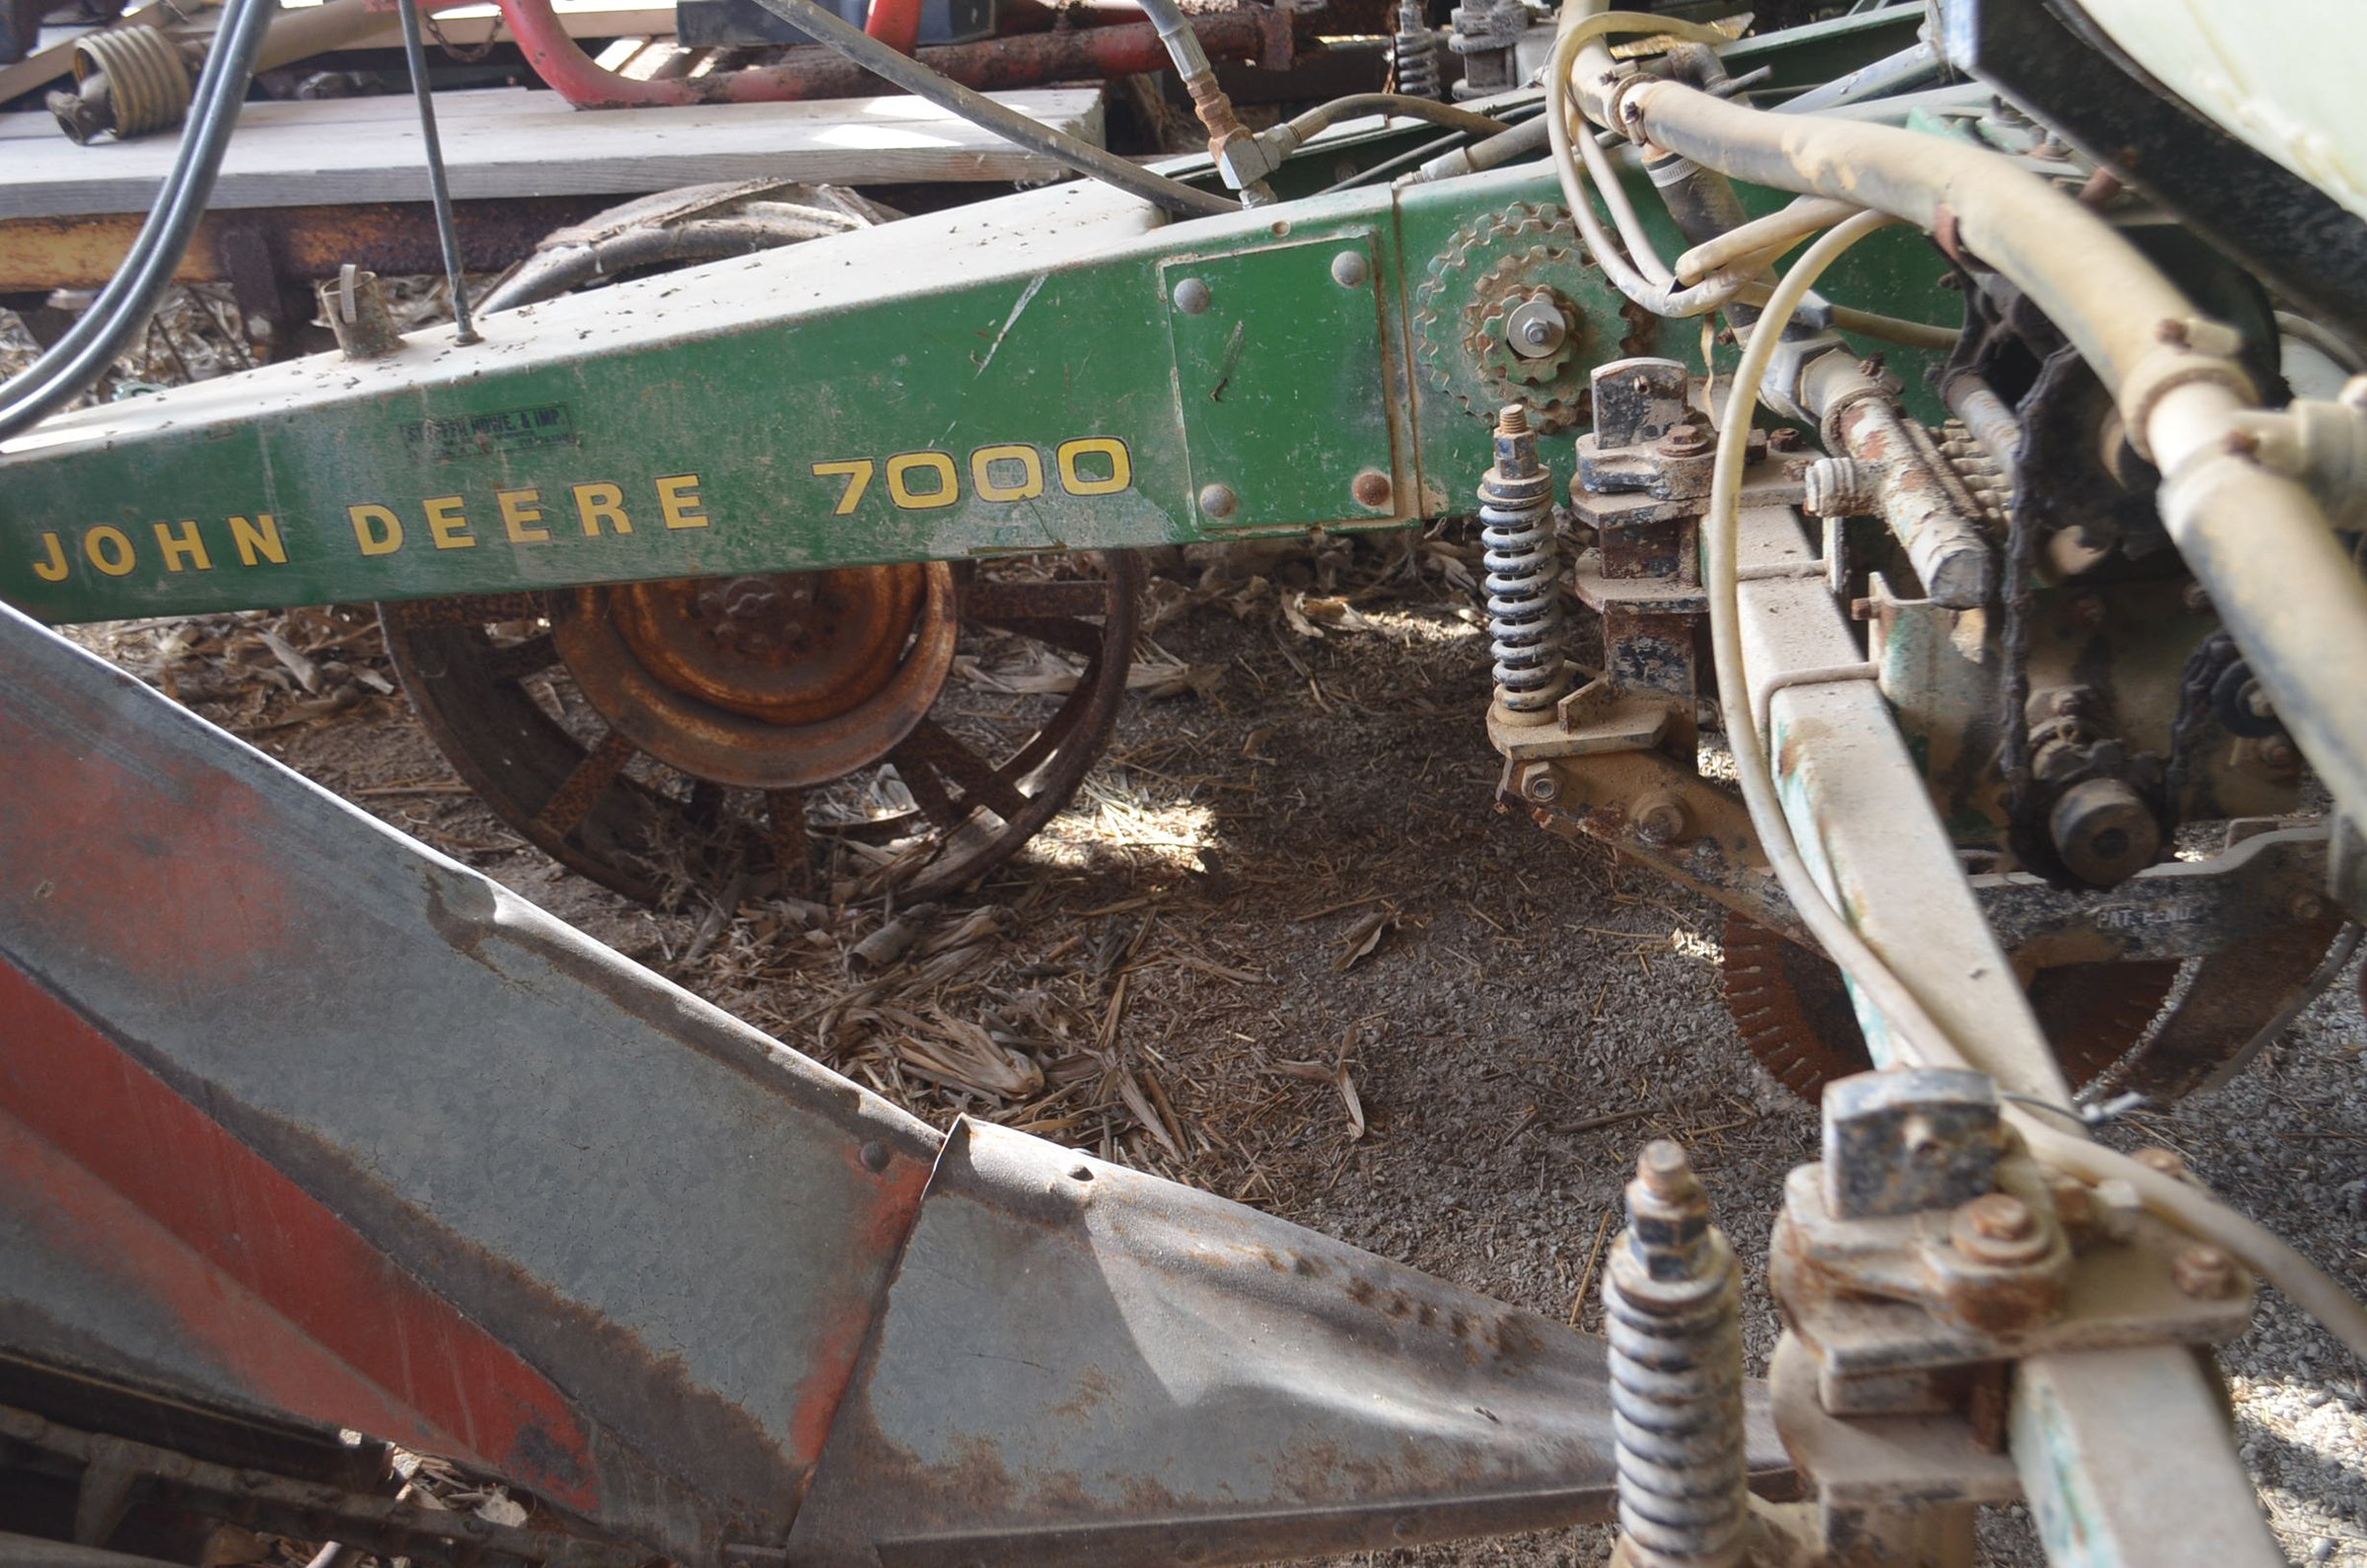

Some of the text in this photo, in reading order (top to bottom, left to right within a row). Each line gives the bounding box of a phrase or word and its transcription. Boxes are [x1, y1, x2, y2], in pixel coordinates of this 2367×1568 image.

[34, 438, 1132, 582] JOHN DEERE 7000
